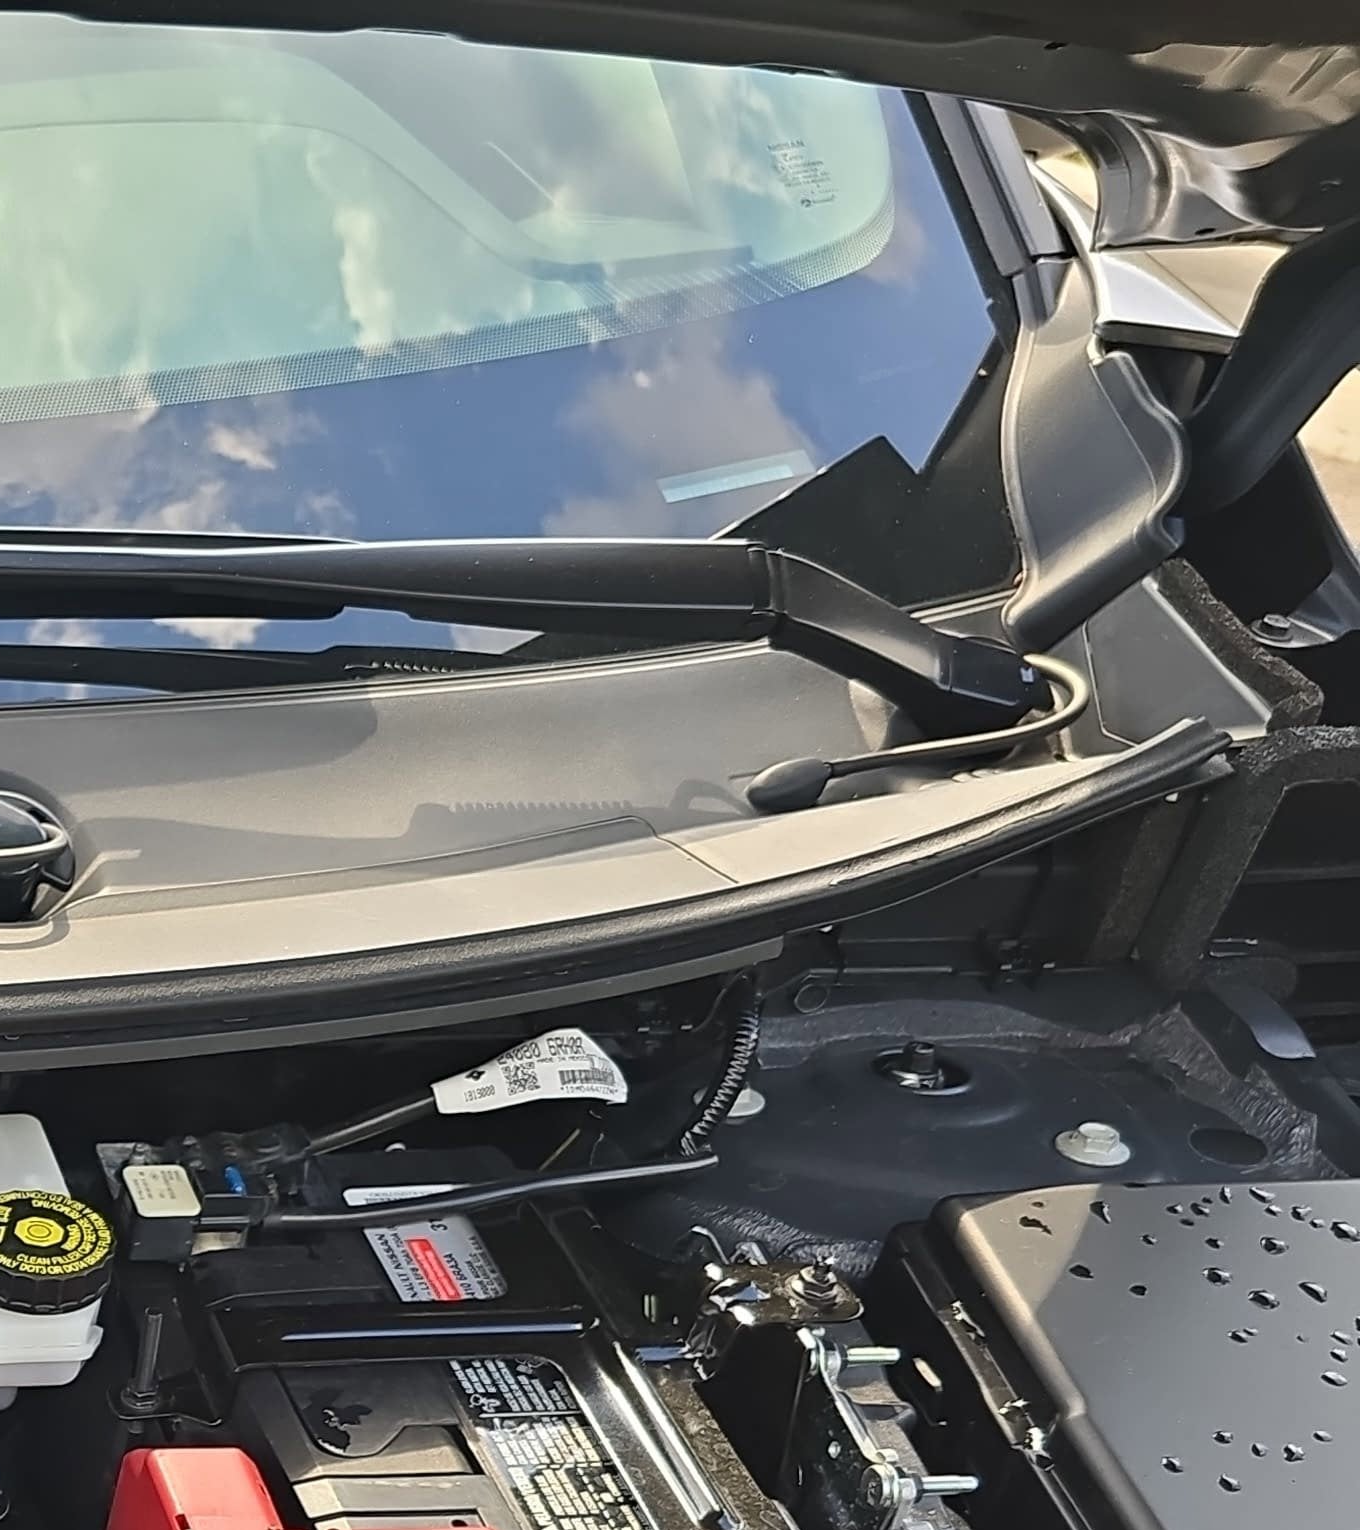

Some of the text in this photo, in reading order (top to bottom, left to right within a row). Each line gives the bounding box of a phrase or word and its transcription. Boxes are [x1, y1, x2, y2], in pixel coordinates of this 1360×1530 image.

[16, 1253, 51, 1265] CLEAN
[19, 1261, 48, 1275] DOT3
[47, 1263, 64, 1275] OR
